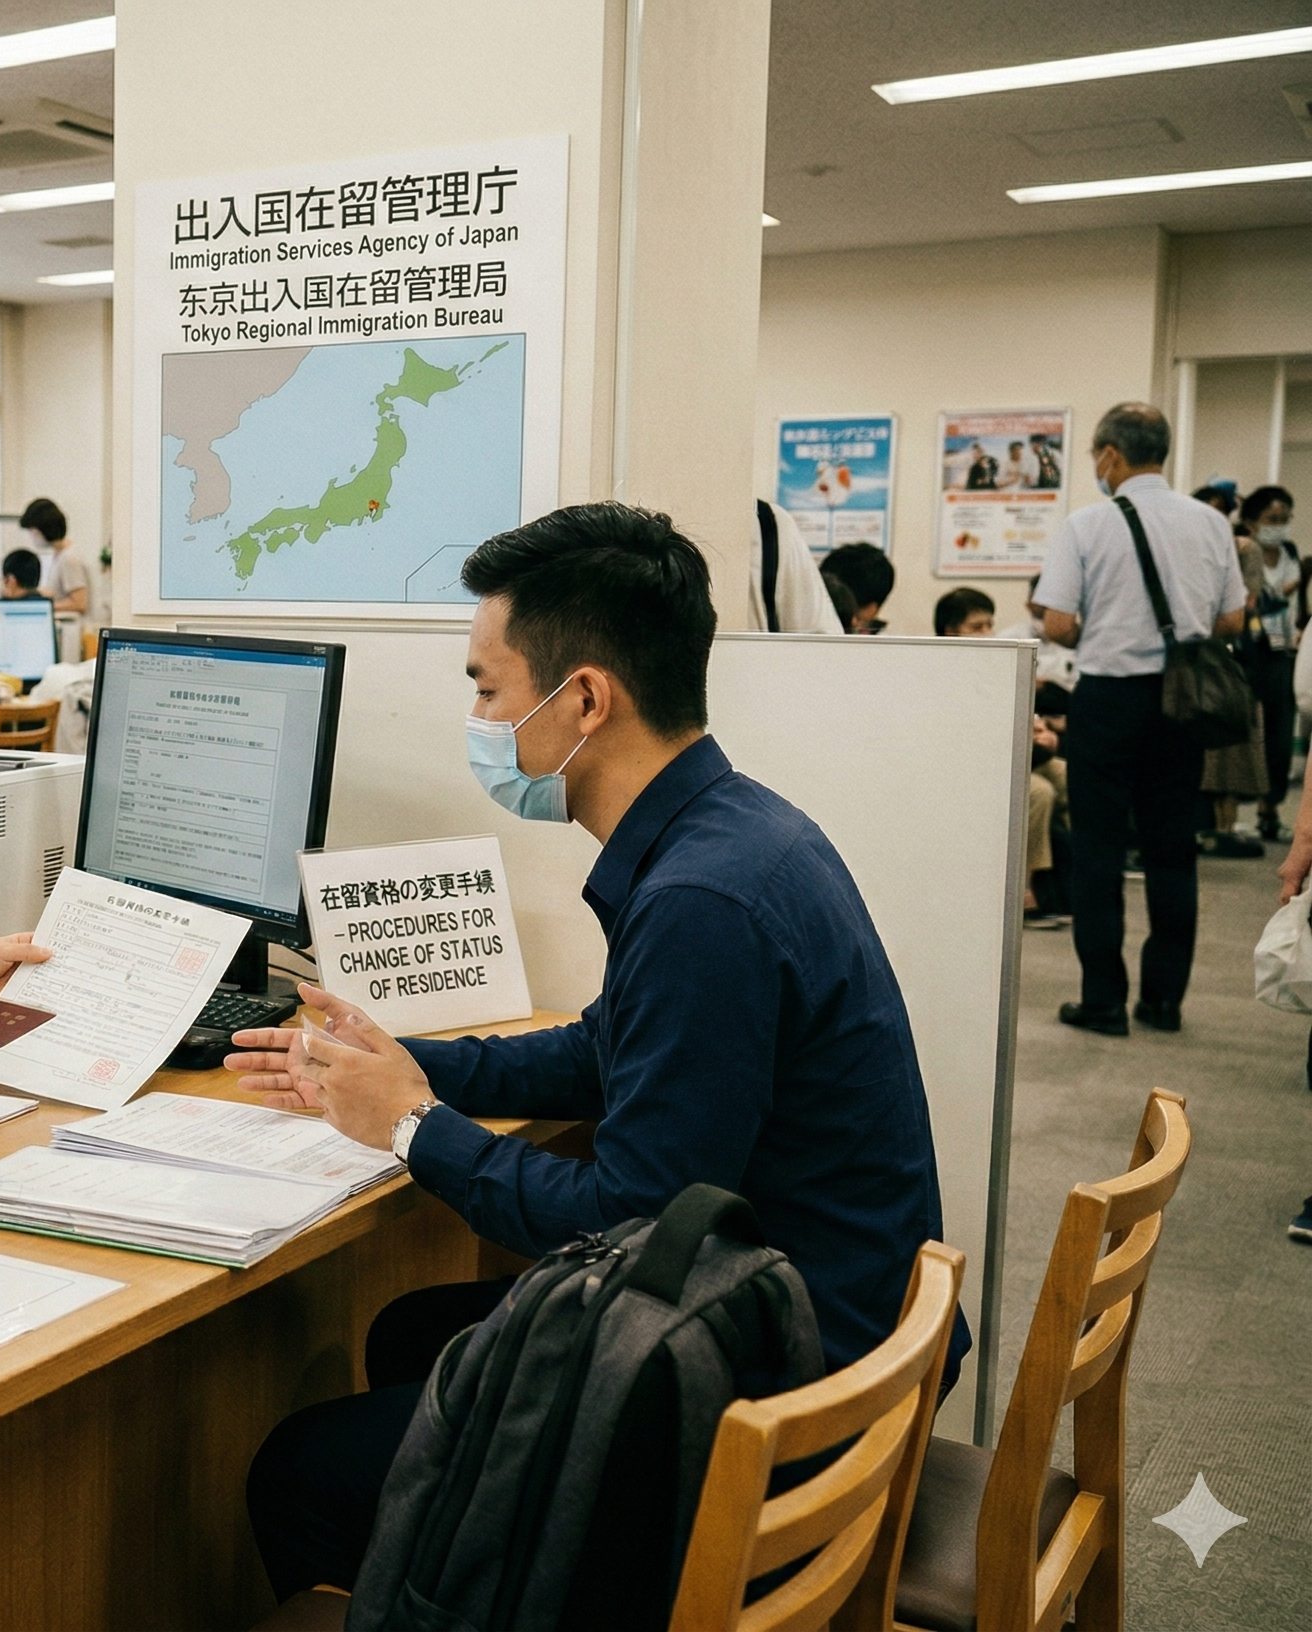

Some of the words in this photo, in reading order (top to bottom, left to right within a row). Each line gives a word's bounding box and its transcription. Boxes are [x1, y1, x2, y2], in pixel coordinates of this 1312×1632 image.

[174, 166, 518, 244] 出入国在留管理庁
[169, 245, 272, 271] Immigration
[276, 235, 354, 259] Services
[359, 233, 429, 258] Agency
[435, 227, 456, 247] of
[460, 225, 520, 247] Japan
[181, 324, 231, 345] Tokyo
[236, 315, 313, 342] Regional
[317, 309, 428, 337] Immigration
[434, 304, 505, 328] Bureau
[348, 912, 459, 943] PROCEDURES
[462, 907, 496, 930] FOR
[339, 946, 410, 974] CHANGE
[414, 943, 435, 965] OF
[440, 935, 503, 961] STATUS
[369, 979, 391, 1000] OF
[396, 966, 488, 997] RESIDENCE
